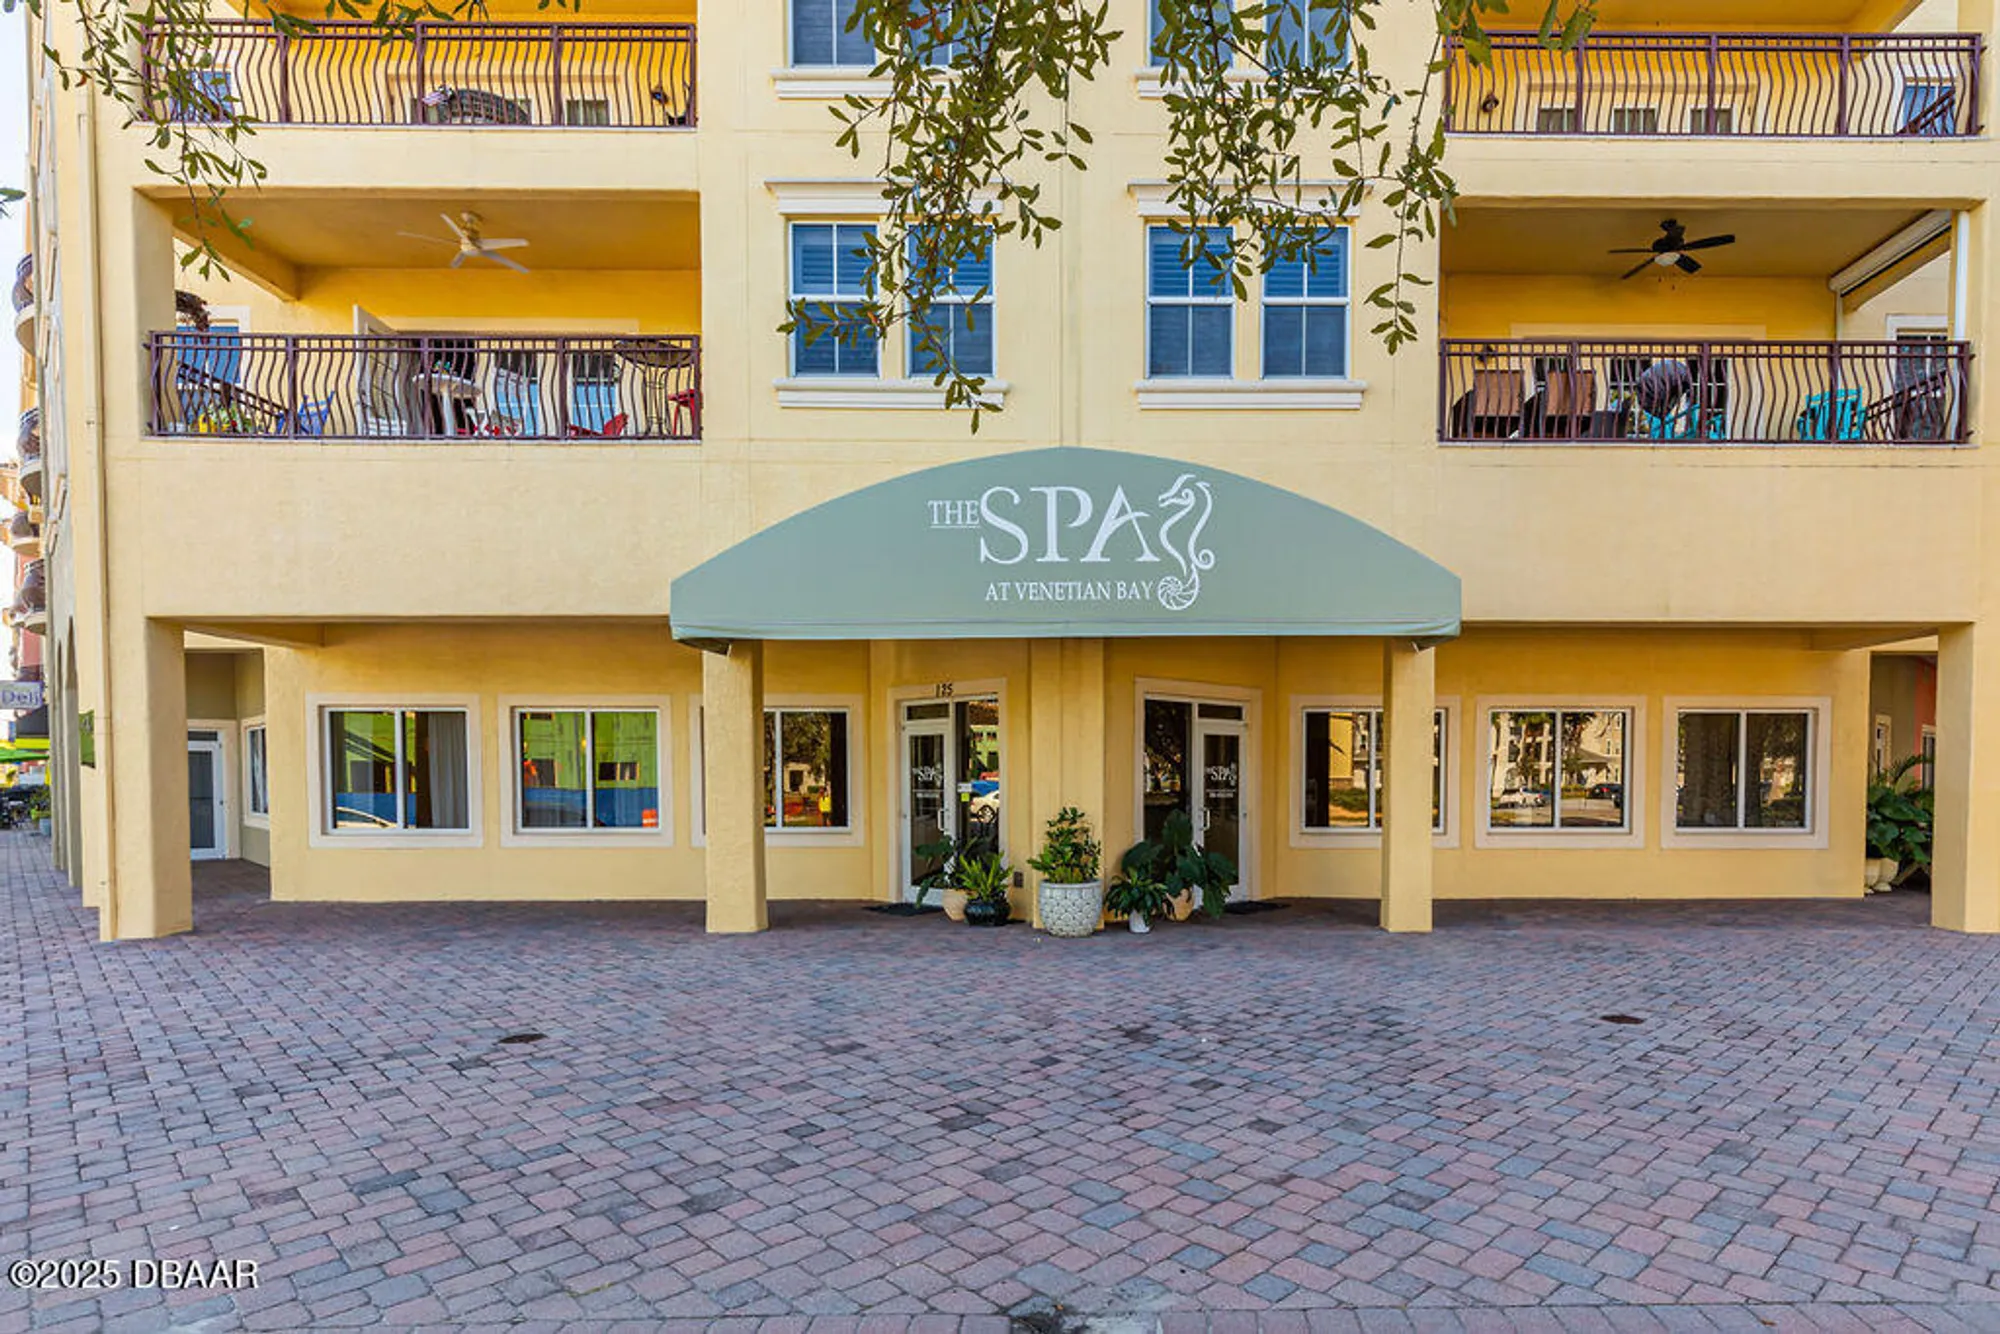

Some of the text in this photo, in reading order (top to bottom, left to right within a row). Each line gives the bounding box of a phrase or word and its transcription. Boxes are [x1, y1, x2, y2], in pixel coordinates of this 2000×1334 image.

[928, 485, 1160, 564] THE SPA
[985, 582, 1153, 601] AT VENETIAN BAY
